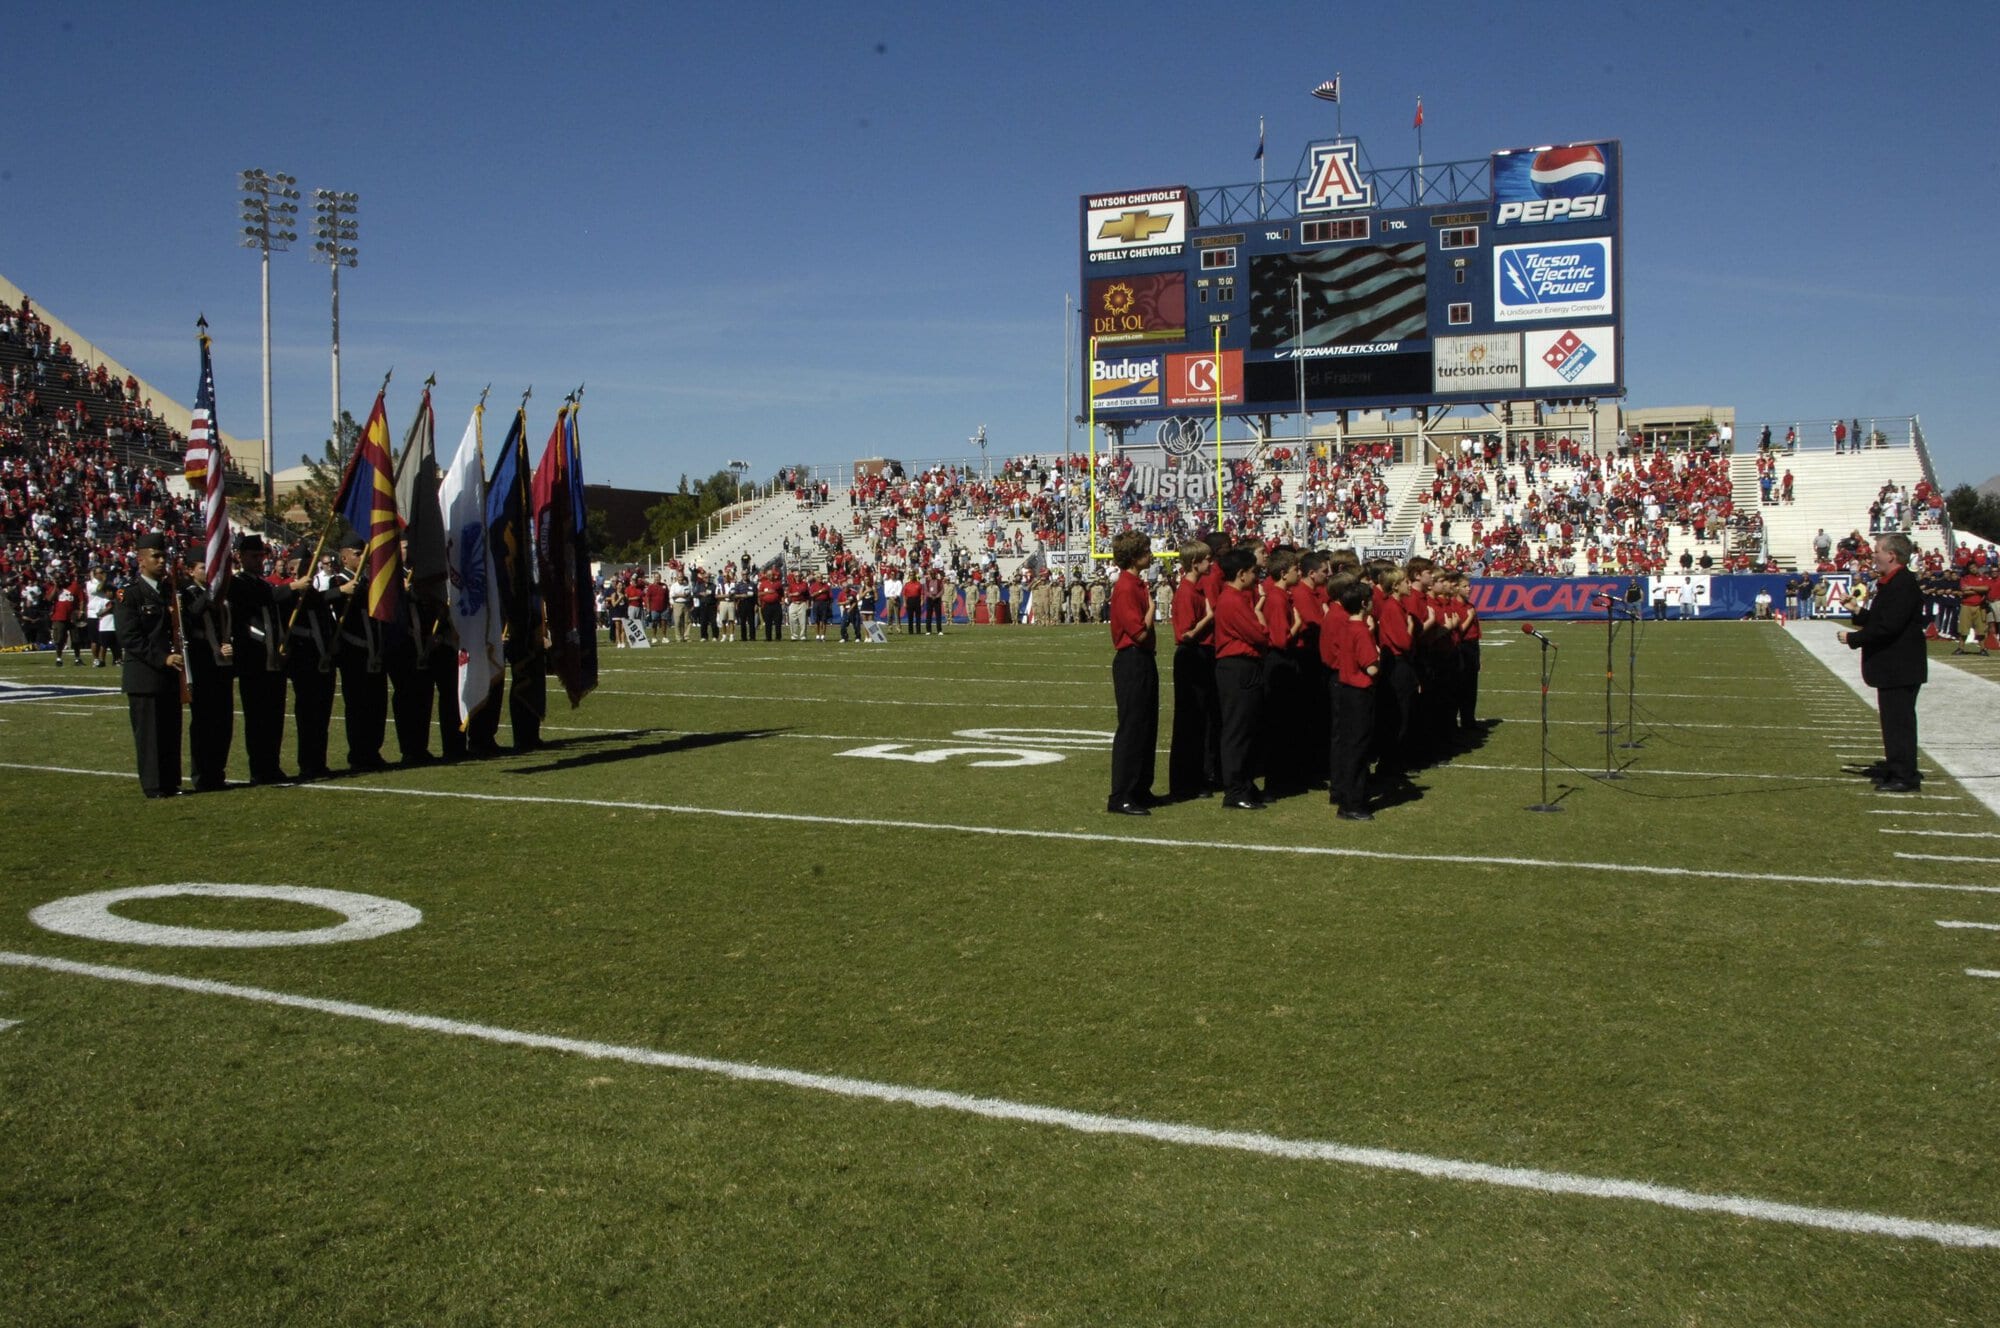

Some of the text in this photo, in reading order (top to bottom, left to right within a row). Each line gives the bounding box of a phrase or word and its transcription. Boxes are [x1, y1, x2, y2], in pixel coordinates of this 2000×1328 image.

[1301, 145, 1369, 211] A
[1089, 190, 1182, 209] WATSON CHEVROLET
[1496, 194, 1607, 225] PEPSI
[1390, 220, 1408, 230] TOL
[1265, 232, 1282, 241] TOL
[1089, 245, 1183, 262] O'RIELLY CHEVROLET
[1525, 253, 1580, 270] Tucson
[1531, 264, 1596, 282] Electric
[1537, 280, 1596, 296] Power
[1506, 307, 1544, 317] UniSource
[1544, 306, 1570, 314] Energy
[1571, 303, 1606, 313] Company
[1095, 315, 1144, 333] DEL SOL
[1093, 358, 1159, 383] Budget
[1437, 363, 1519, 378] tucson.com
[1565, 362, 1586, 382] Pizza
[1106, 398, 1119, 407] and
[1120, 398, 1138, 406] truck
[1139, 397, 1158, 405] sales
[1122, 464, 1234, 499] Allstate
[1469, 584, 1619, 613] ILDCATS
